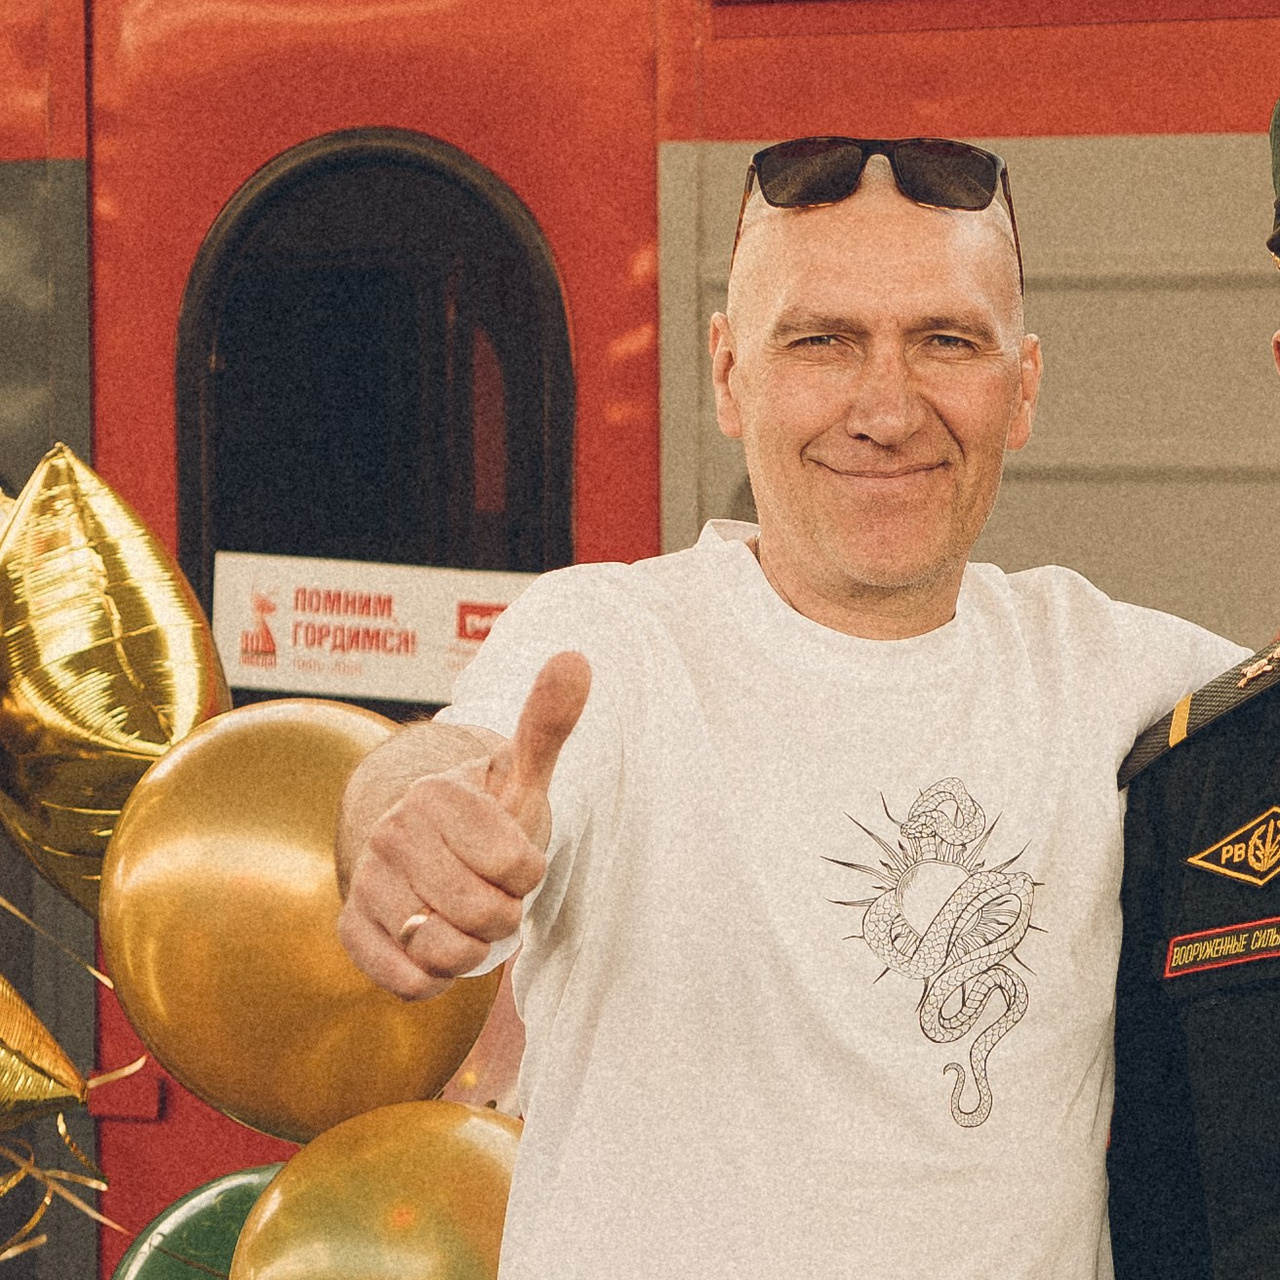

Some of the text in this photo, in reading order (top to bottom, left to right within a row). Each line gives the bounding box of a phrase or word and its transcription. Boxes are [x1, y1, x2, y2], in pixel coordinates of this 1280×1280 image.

[292, 619, 417, 655] ГОРДИМСЯ!
[1221, 843, 1246, 865] РВ
[1171, 933, 1249, 967] ВООРУЖЕННЫЕ
